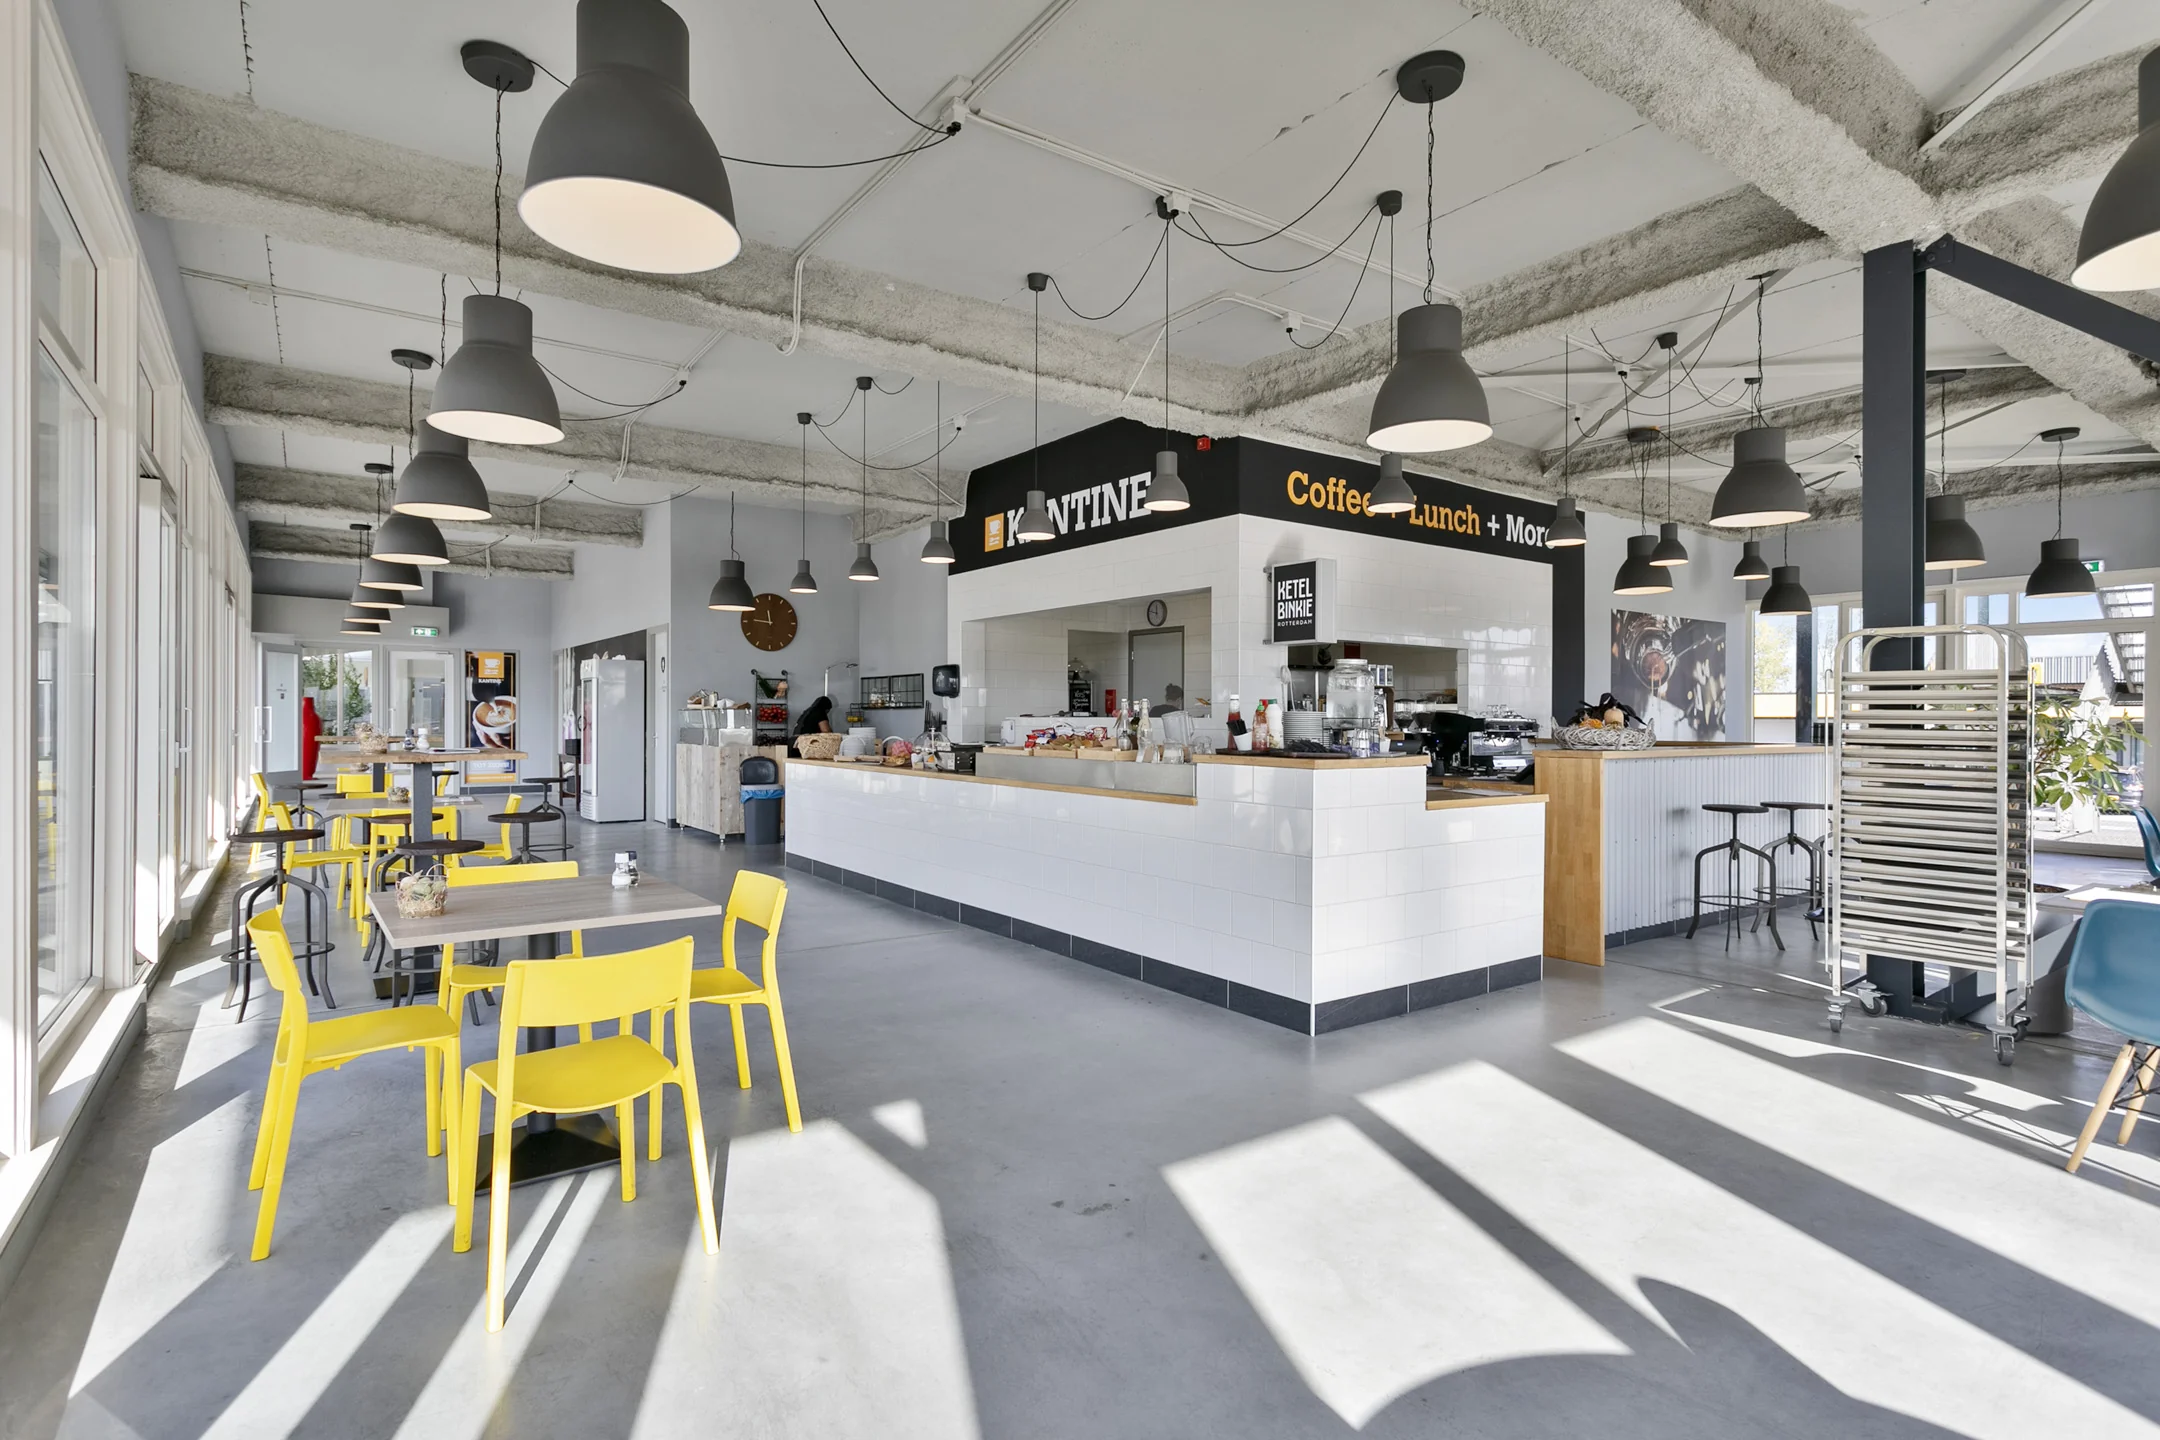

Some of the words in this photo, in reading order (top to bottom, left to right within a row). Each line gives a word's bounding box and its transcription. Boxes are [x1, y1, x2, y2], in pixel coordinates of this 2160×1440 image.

[1006, 471, 1151, 548] KNTINE
[1409, 495, 1481, 536] Lunch
[1487, 514, 1500, 537] +
[1278, 577, 1313, 601] KETEL
[1278, 598, 1313, 620] BINKIE
[1277, 619, 1313, 627] ROTTERDAM
